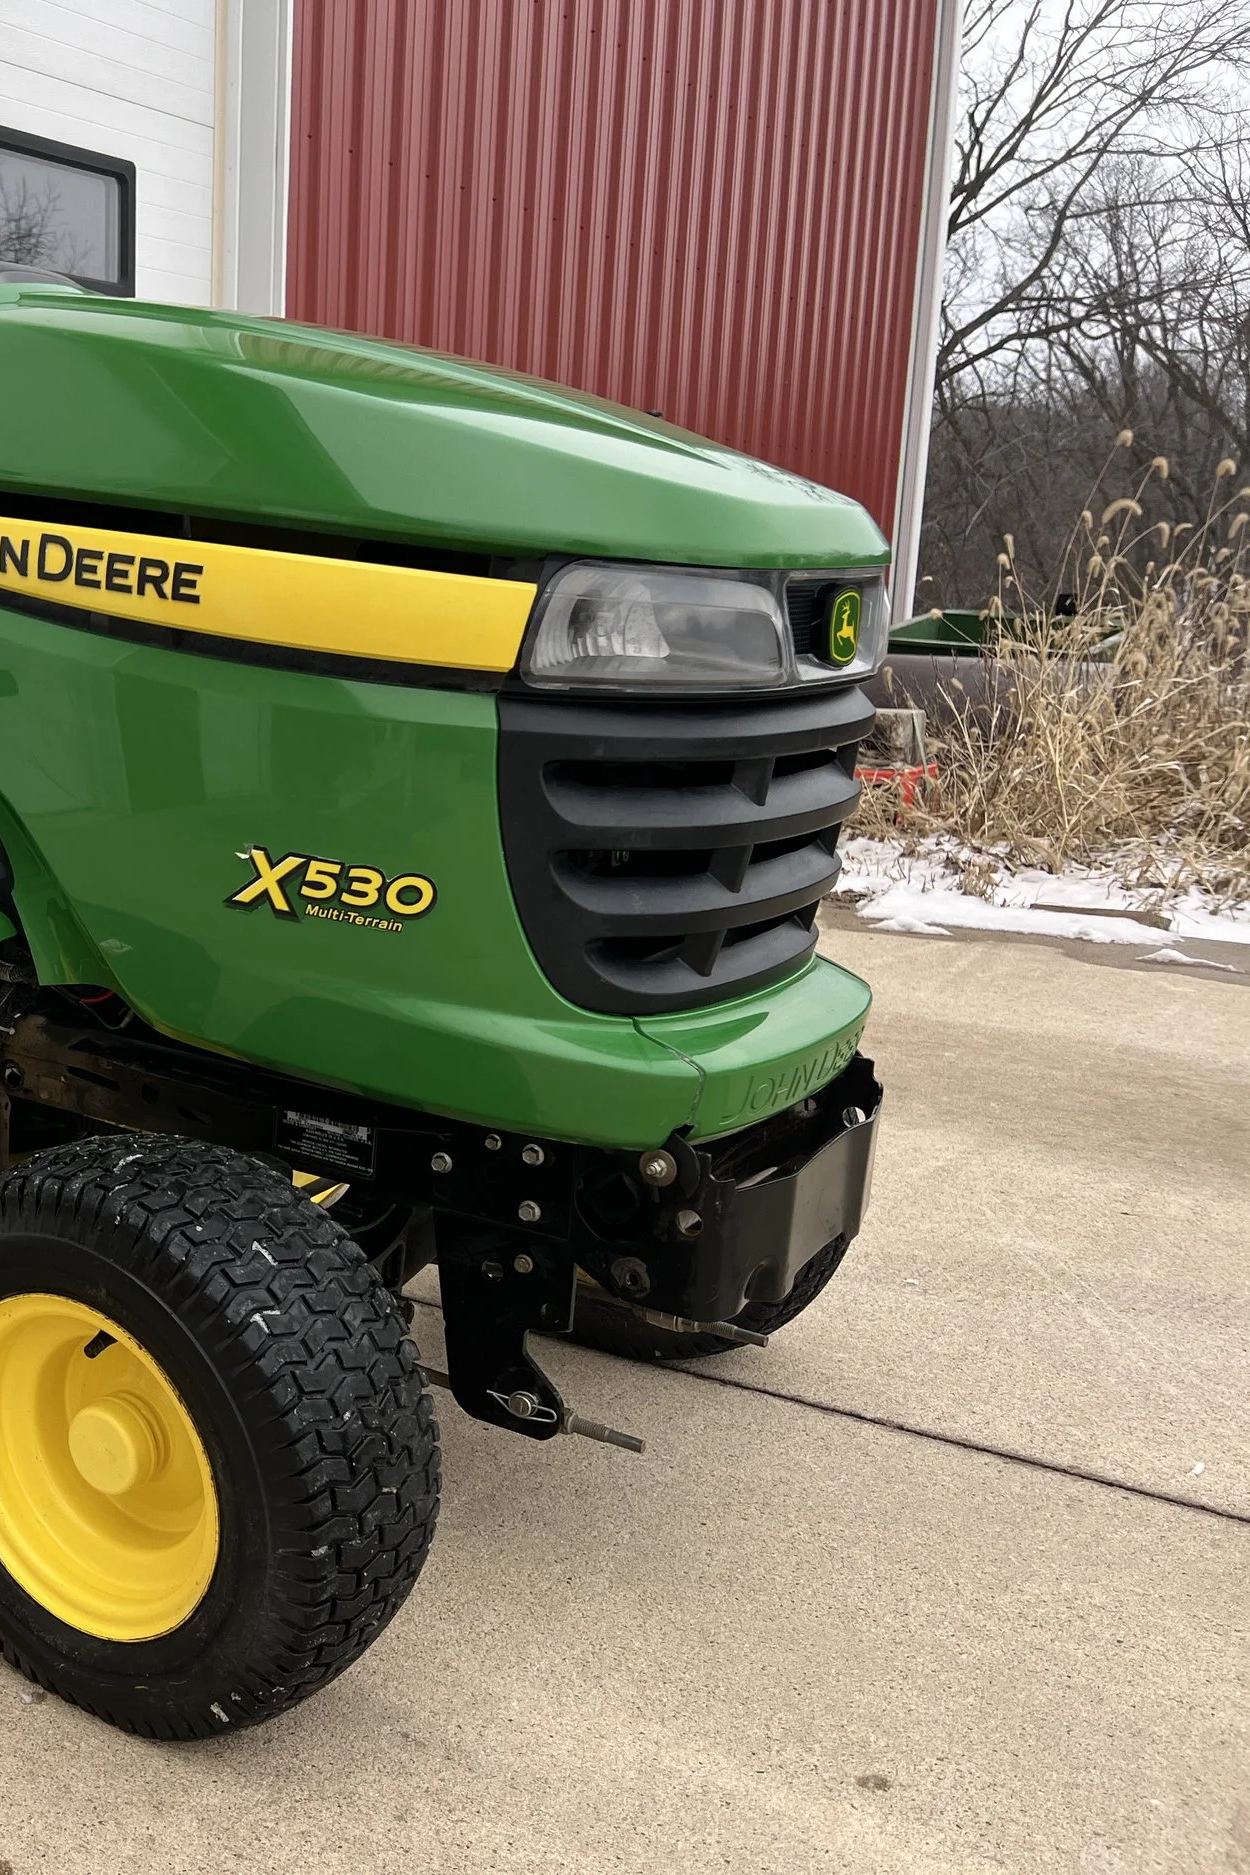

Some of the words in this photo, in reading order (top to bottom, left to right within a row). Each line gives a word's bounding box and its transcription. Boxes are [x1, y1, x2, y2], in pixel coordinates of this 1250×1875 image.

[38, 533, 204, 604] DEERE
[225, 846, 437, 920] X530
[304, 904, 404, 933] Multi-Terrain
[718, 1058, 818, 1126] JOHN
